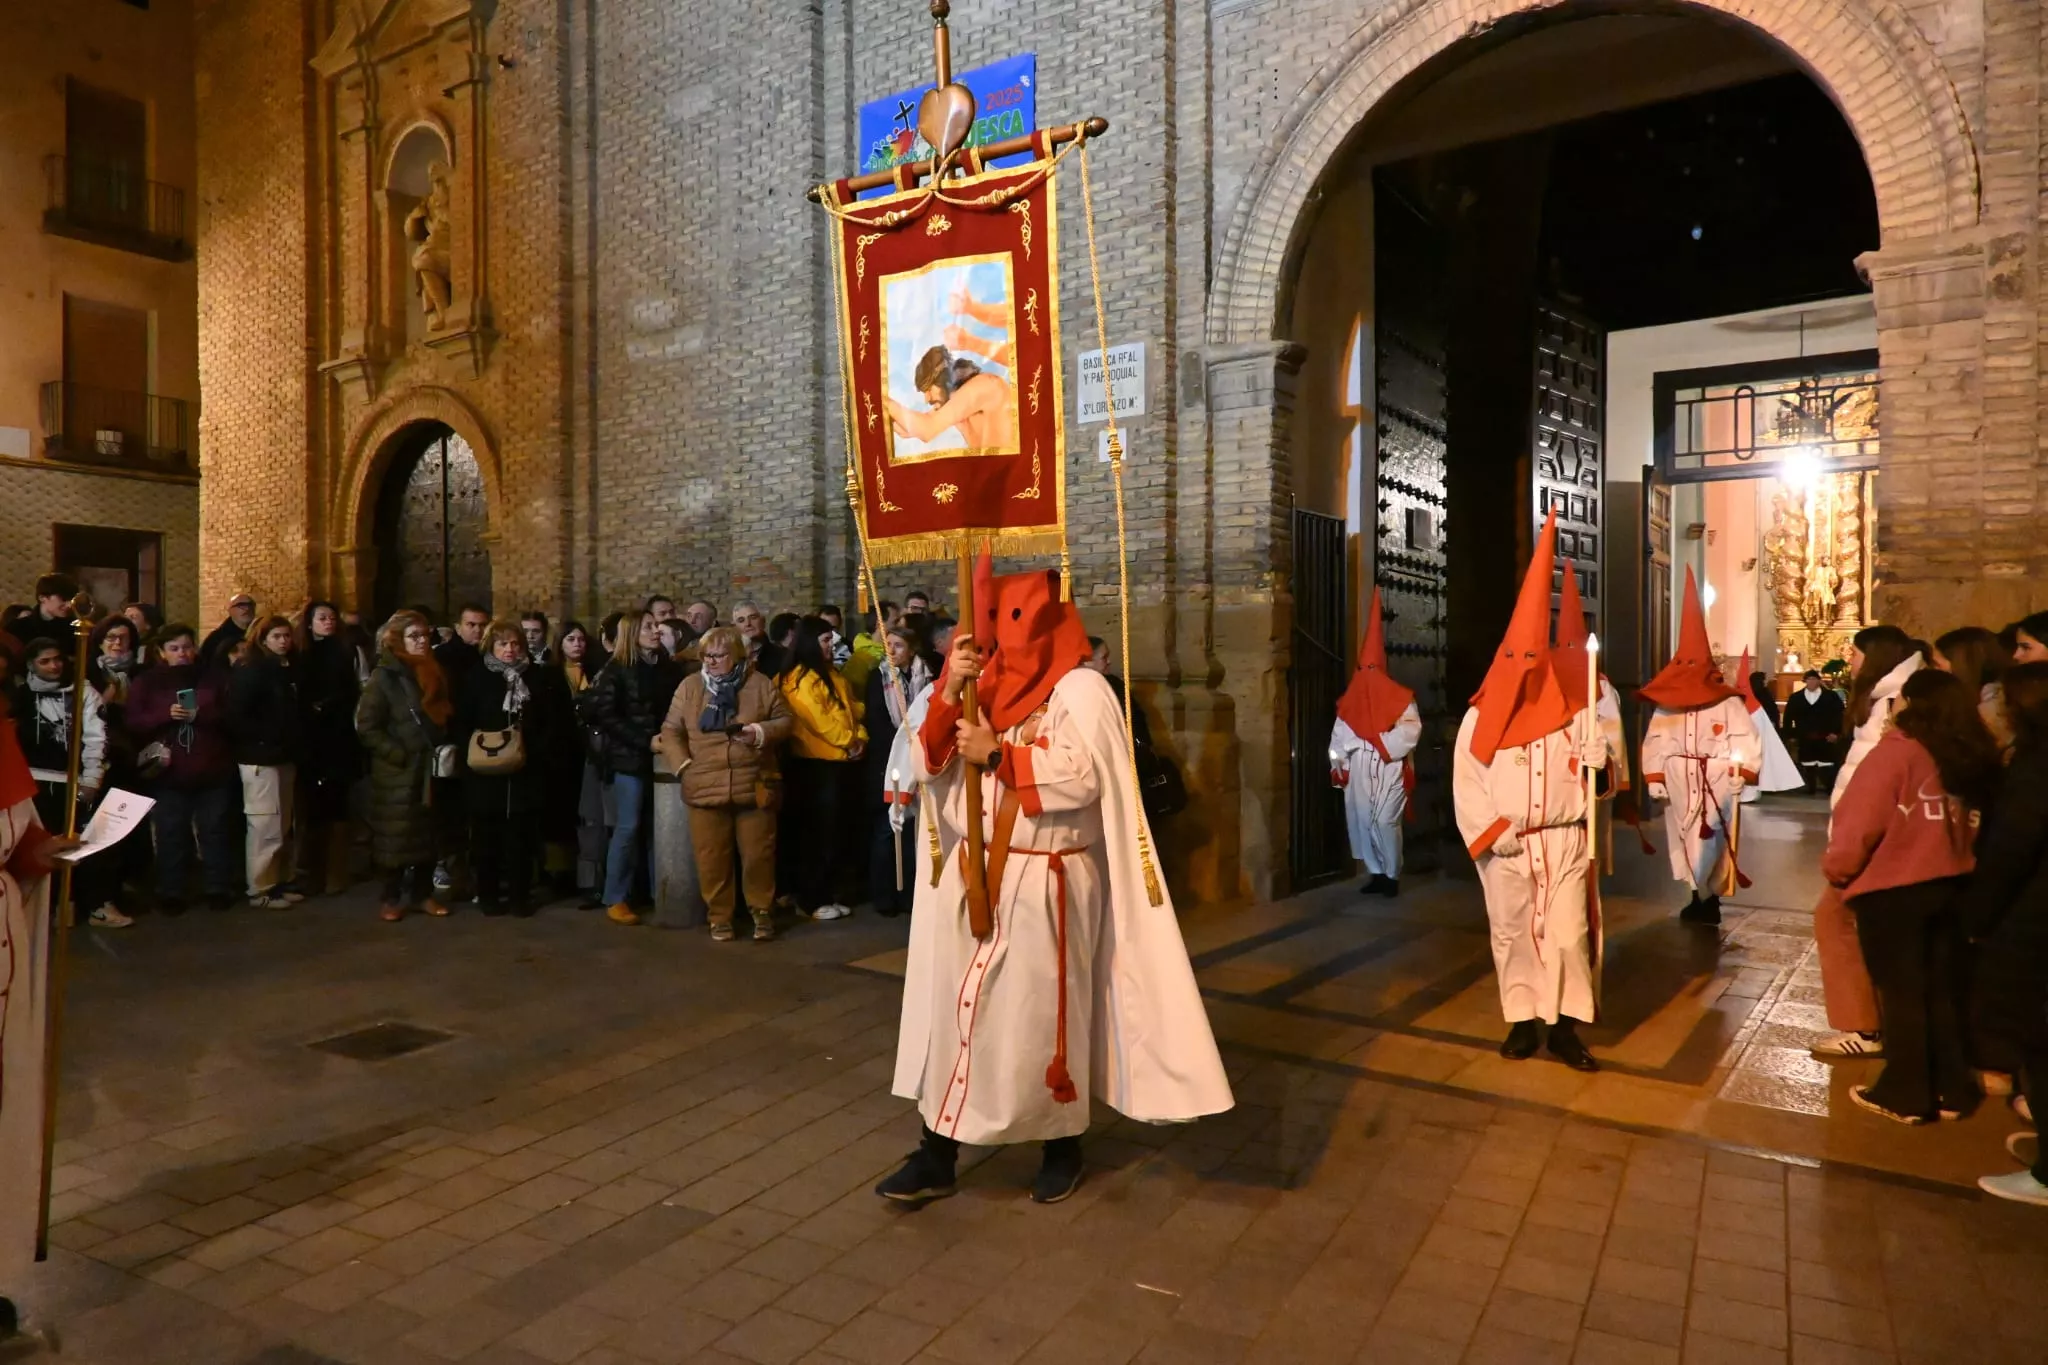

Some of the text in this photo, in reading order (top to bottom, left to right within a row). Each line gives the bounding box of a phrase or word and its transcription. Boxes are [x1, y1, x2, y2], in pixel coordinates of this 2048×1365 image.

[985, 84, 1023, 110] 2025
[964, 109, 1024, 147] UESCA
[1084, 354, 1116, 370] BASILCA
[1083, 373, 1088, 385] Y
